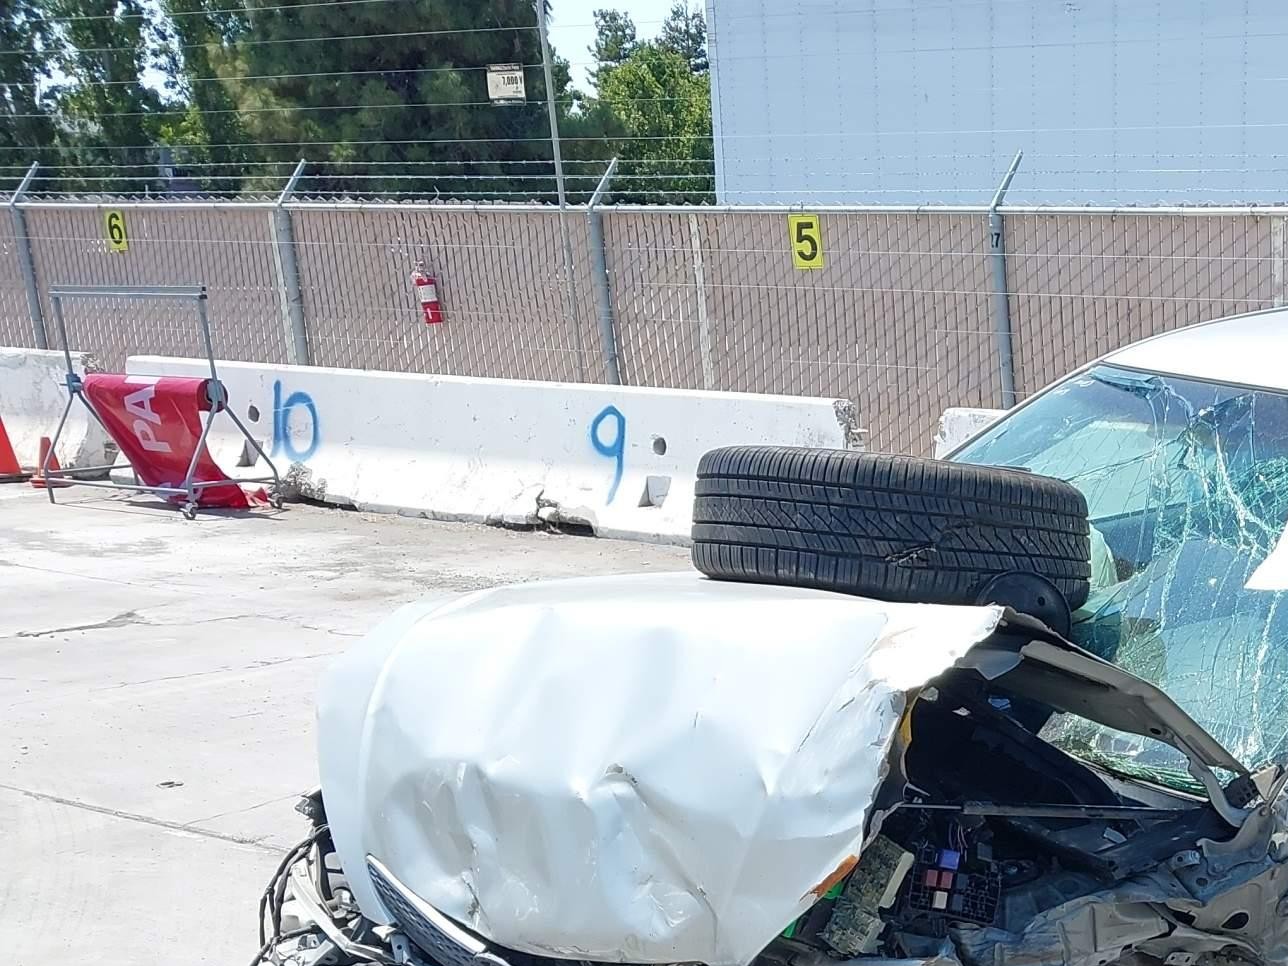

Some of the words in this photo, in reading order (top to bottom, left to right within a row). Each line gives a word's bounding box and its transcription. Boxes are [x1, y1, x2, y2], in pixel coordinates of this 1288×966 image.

[108, 212, 123, 244] 6
[796, 221, 818, 261] 5
[124, 376, 172, 453] PA
[270, 379, 319, 461] 10
[590, 404, 626, 505] 9
